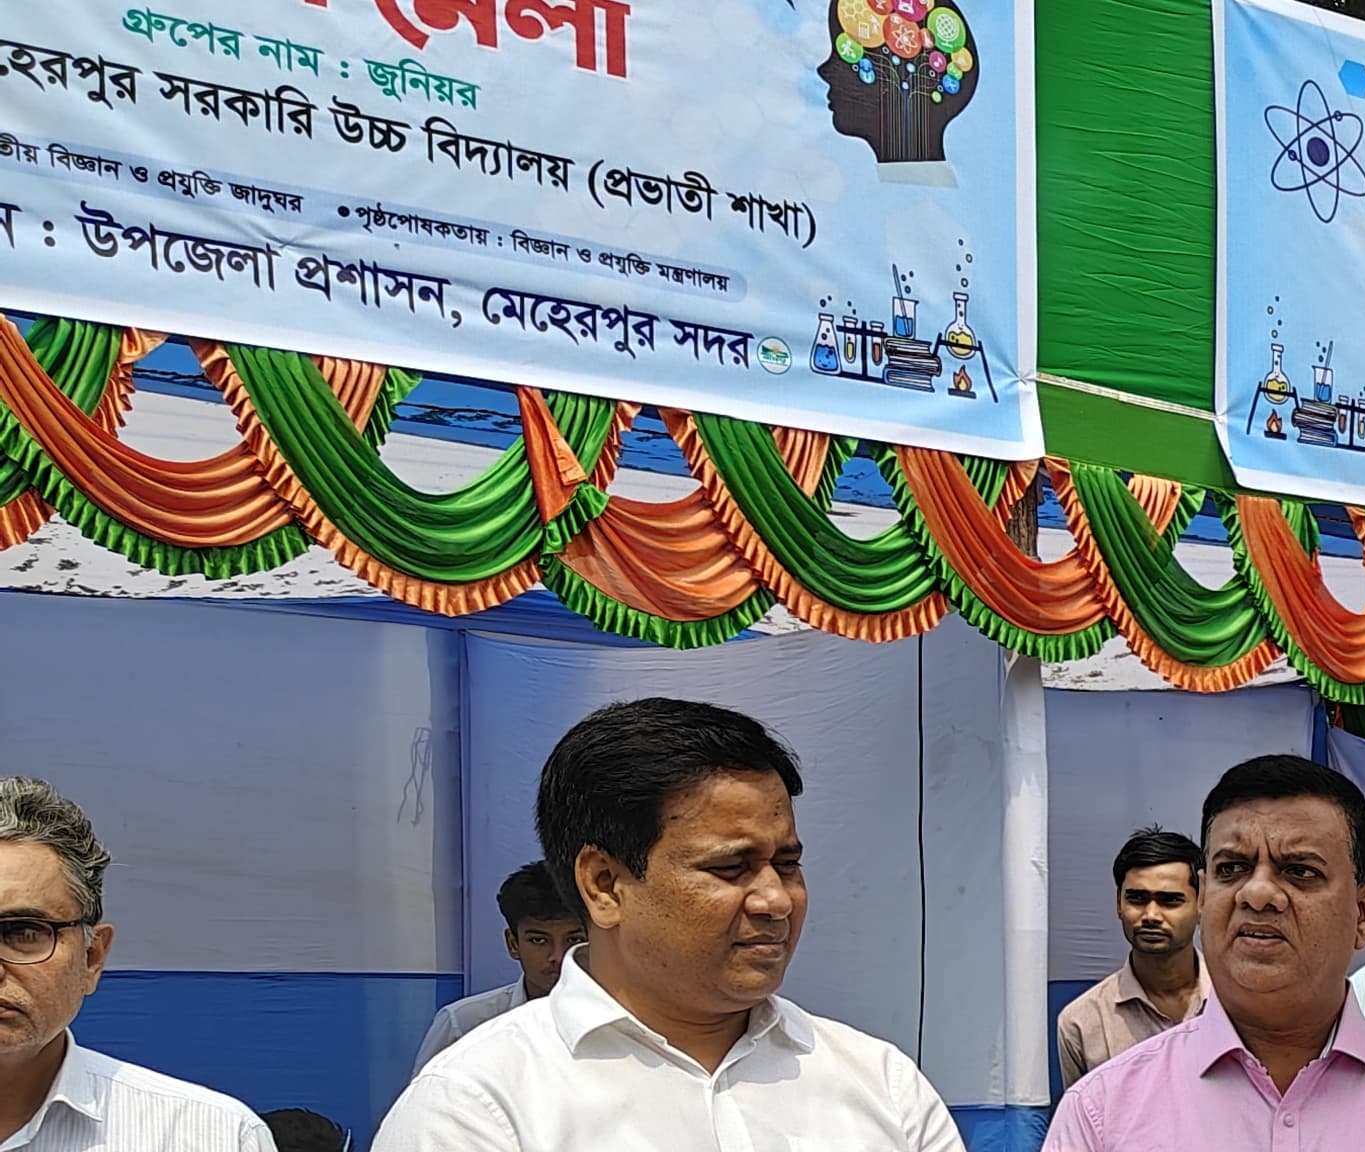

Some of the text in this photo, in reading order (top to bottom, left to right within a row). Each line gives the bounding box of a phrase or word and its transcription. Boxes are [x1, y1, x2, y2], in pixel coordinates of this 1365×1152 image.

[122, 7, 243, 60] গ্রুপের
[254, 34, 325, 78] নাম
[364, 56, 480, 110] জুনিয়র
[47, 142, 122, 181] বিজ্ঞান
[130, 164, 149, 184] ও
[157, 168, 223, 199] প্রযুক্তি
[228, 182, 304, 214] জাদুঘর
[356, 203, 490, 247] পৃষ্ঠপোষকতায়
[511, 229, 570, 262] বিজ্ঞান
[576, 247, 592, 263] ও
[599, 250, 652, 279] প্রযুক্তি
[657, 262, 730, 293] মন্ত্রণালয়
[154, 70, 318, 140] সরকারি
[330, 96, 413, 153] উচ্চ
[420, 116, 576, 192] বিদ্যালয়
[588, 159, 718, 222] (প্রভাতী
[726, 189, 818, 249] শাখা)
[74, 200, 282, 291] উপজেলা
[295, 252, 462, 329] প্রশাসন,
[481, 287, 662, 360] মেহেরপুর
[669, 318, 756, 368] সদর
